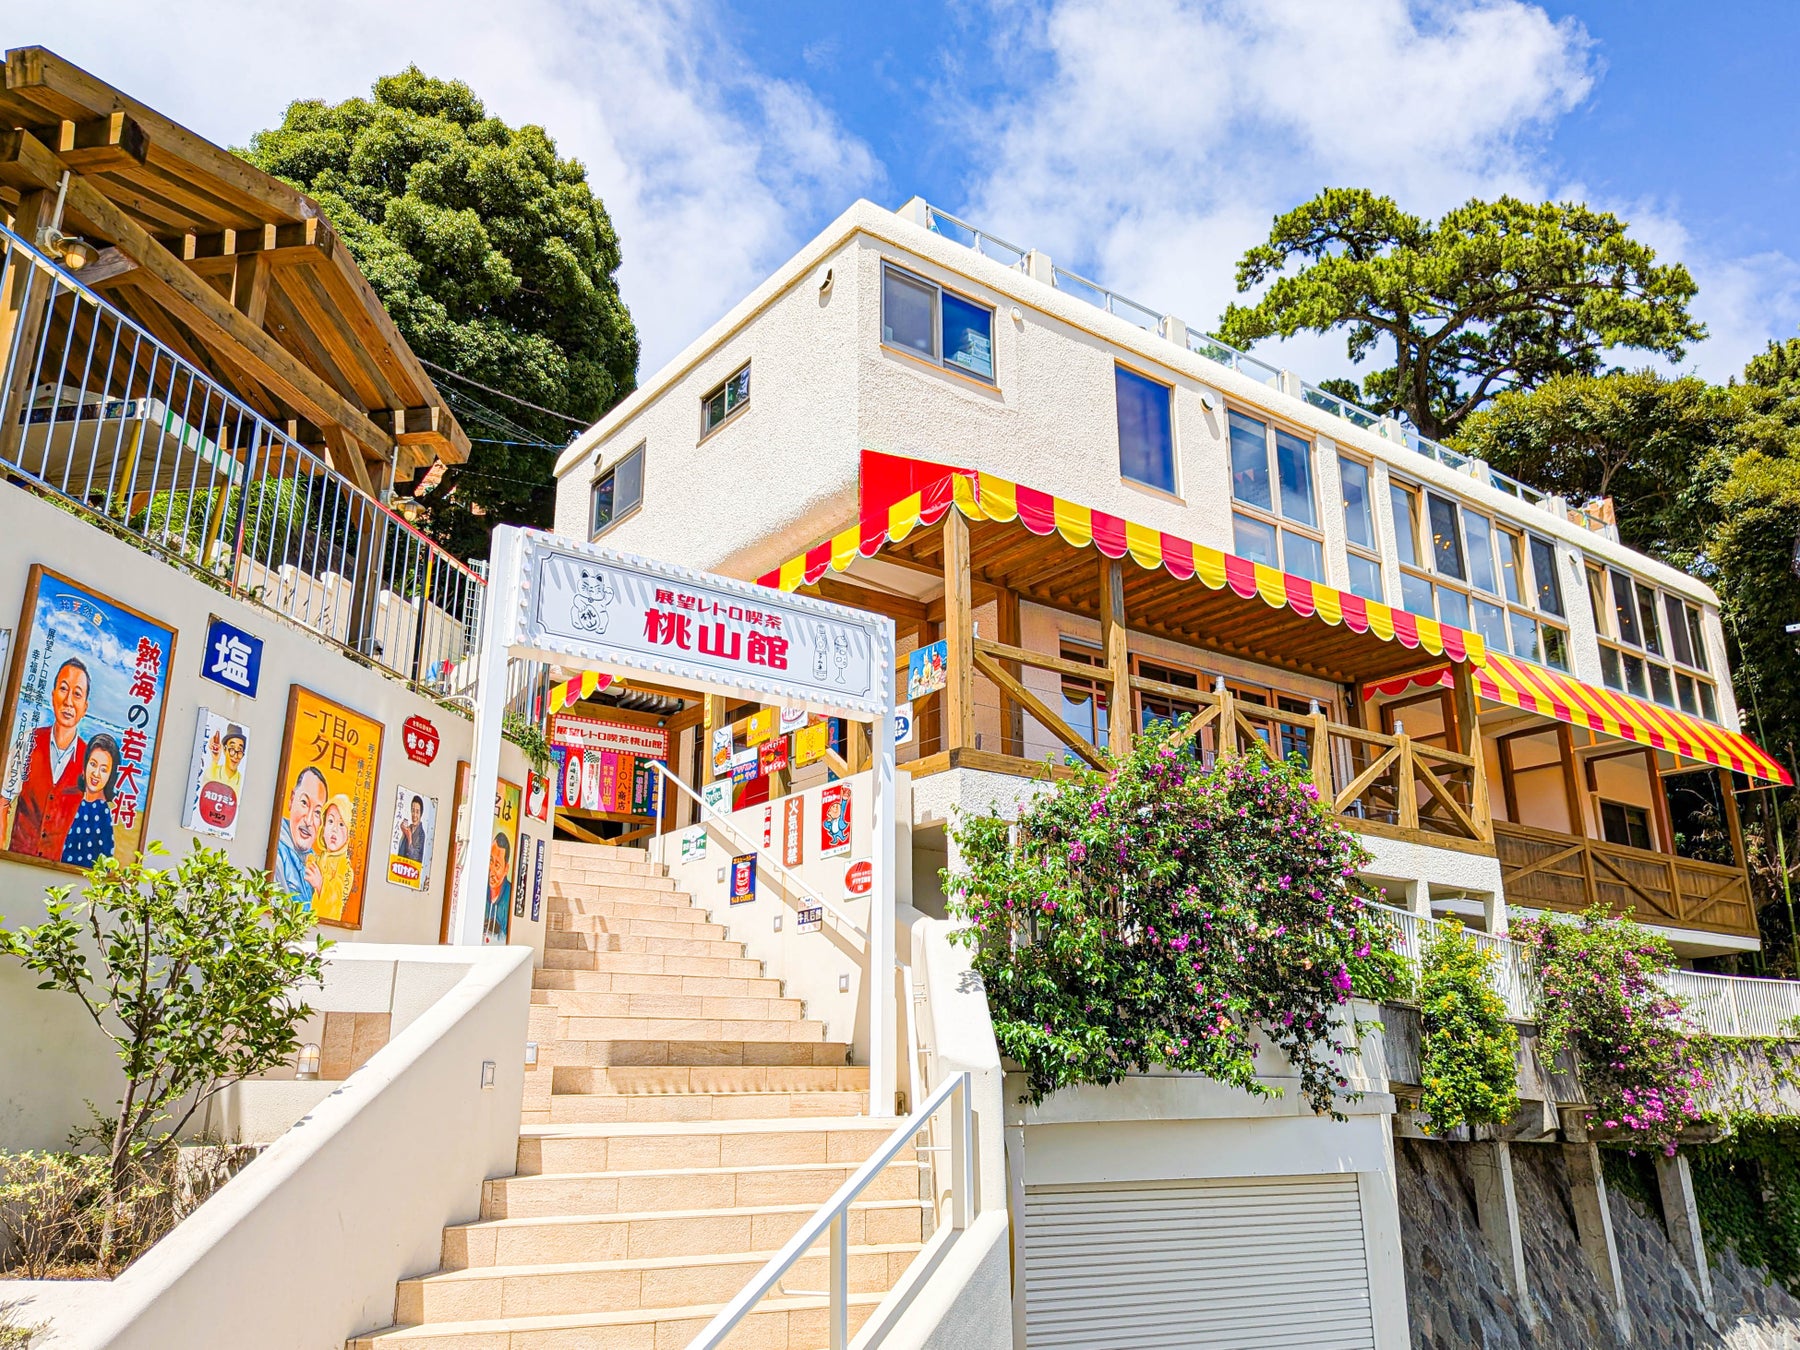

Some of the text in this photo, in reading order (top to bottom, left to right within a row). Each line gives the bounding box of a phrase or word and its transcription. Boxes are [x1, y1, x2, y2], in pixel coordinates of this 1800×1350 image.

[655, 588, 782, 630] 展望レトロ喫茶
[643, 607, 789, 670] 桃山館
[211, 633, 252, 688] 塩
[111, 636, 162, 830] 熱海の若大将
[303, 709, 359, 746] 一丁目の
[407, 732, 435, 757] 味の素
[556, 725, 663, 749] 展望レトロ喫茶桃山館
[309, 736, 348, 773] 夕日
[204, 790, 235, 806] オロナミン
[214, 803, 223, 812] C
[787, 799, 799, 864] 火気厳禁
